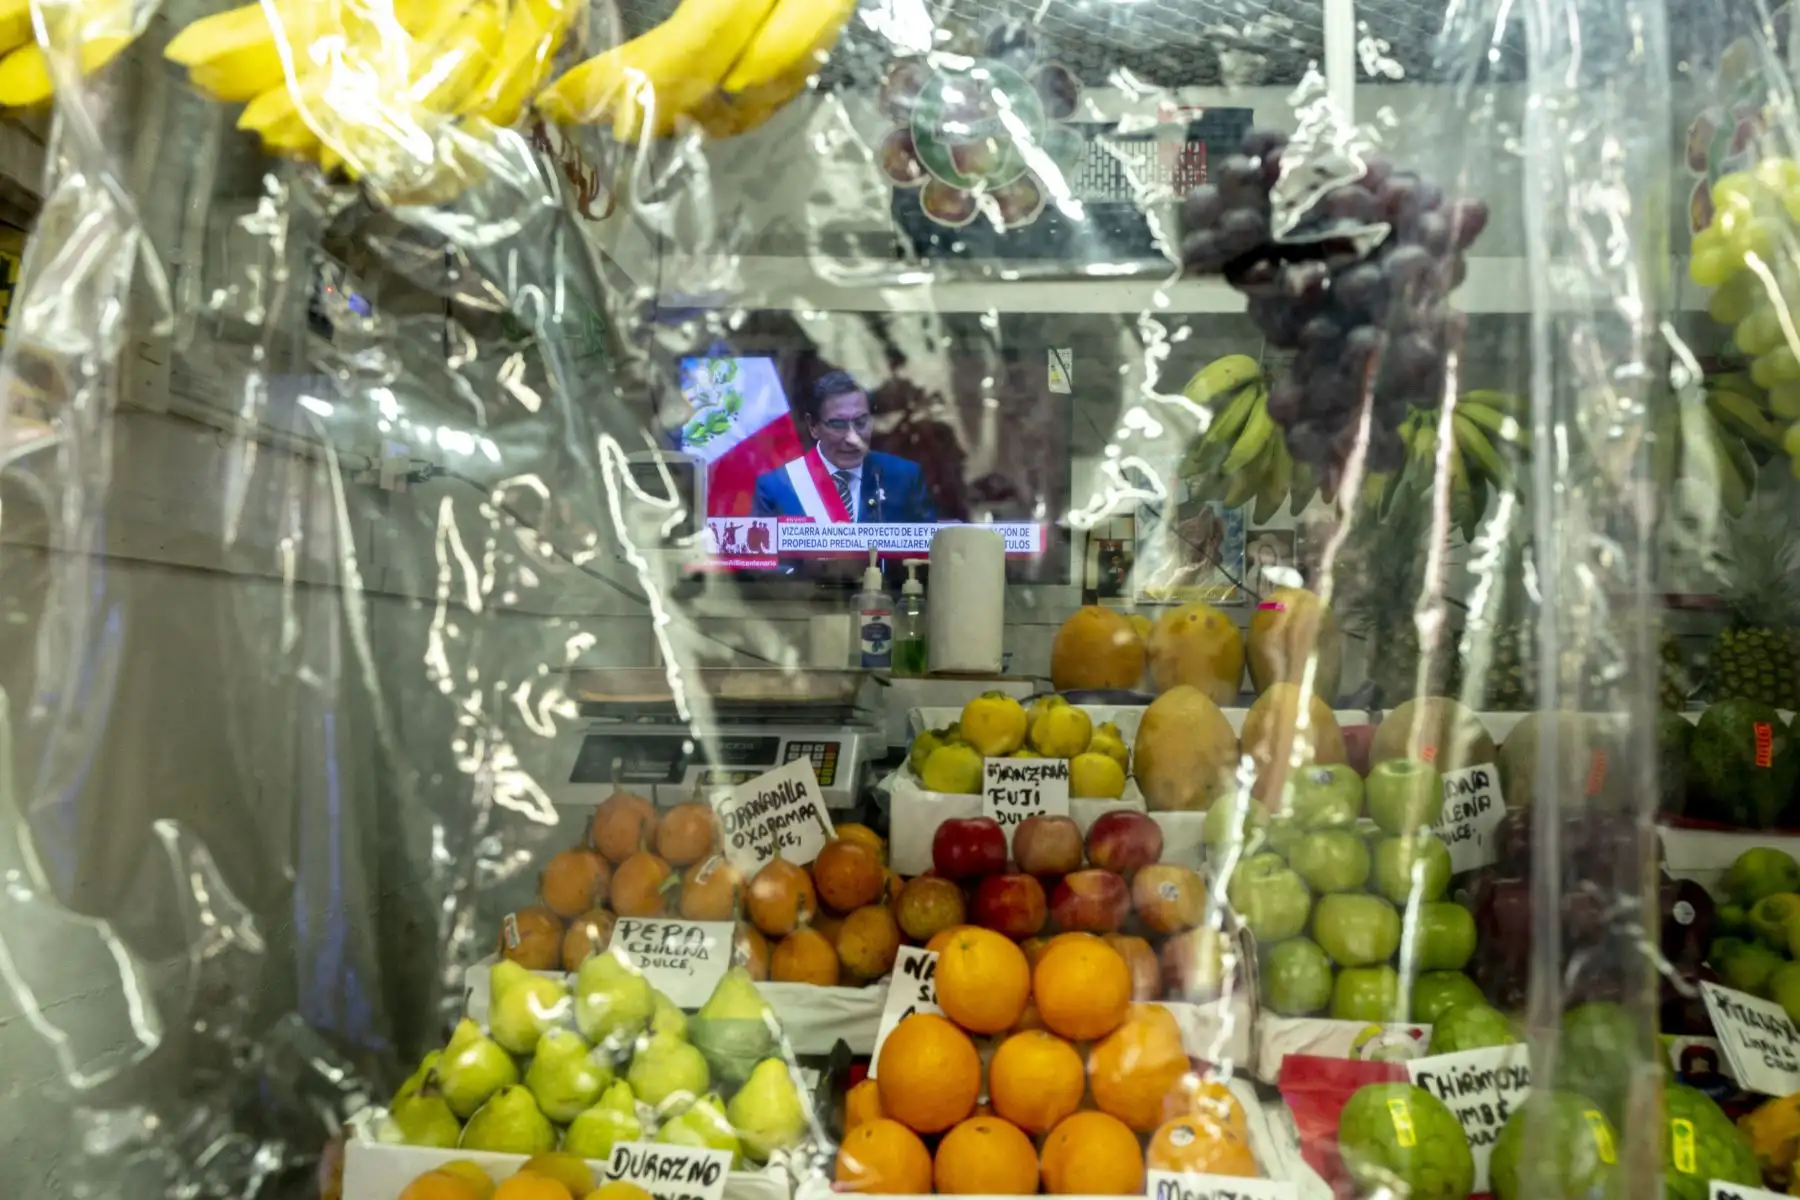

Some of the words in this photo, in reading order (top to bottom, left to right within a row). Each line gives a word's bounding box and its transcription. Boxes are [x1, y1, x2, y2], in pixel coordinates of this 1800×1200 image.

[782, 527, 820, 536] VIZCARRA
[822, 527, 856, 536] ANUNCIA
[858, 527, 900, 537] PROYECTO
[901, 527, 912, 537] DE
[914, 527, 928, 537] LEY
[1020, 528, 1031, 537] DE
[782, 539, 828, 548] PROPIEDAD
[618, 920, 706, 946] PERA
[604, 1146, 721, 1187] DURAZNO
